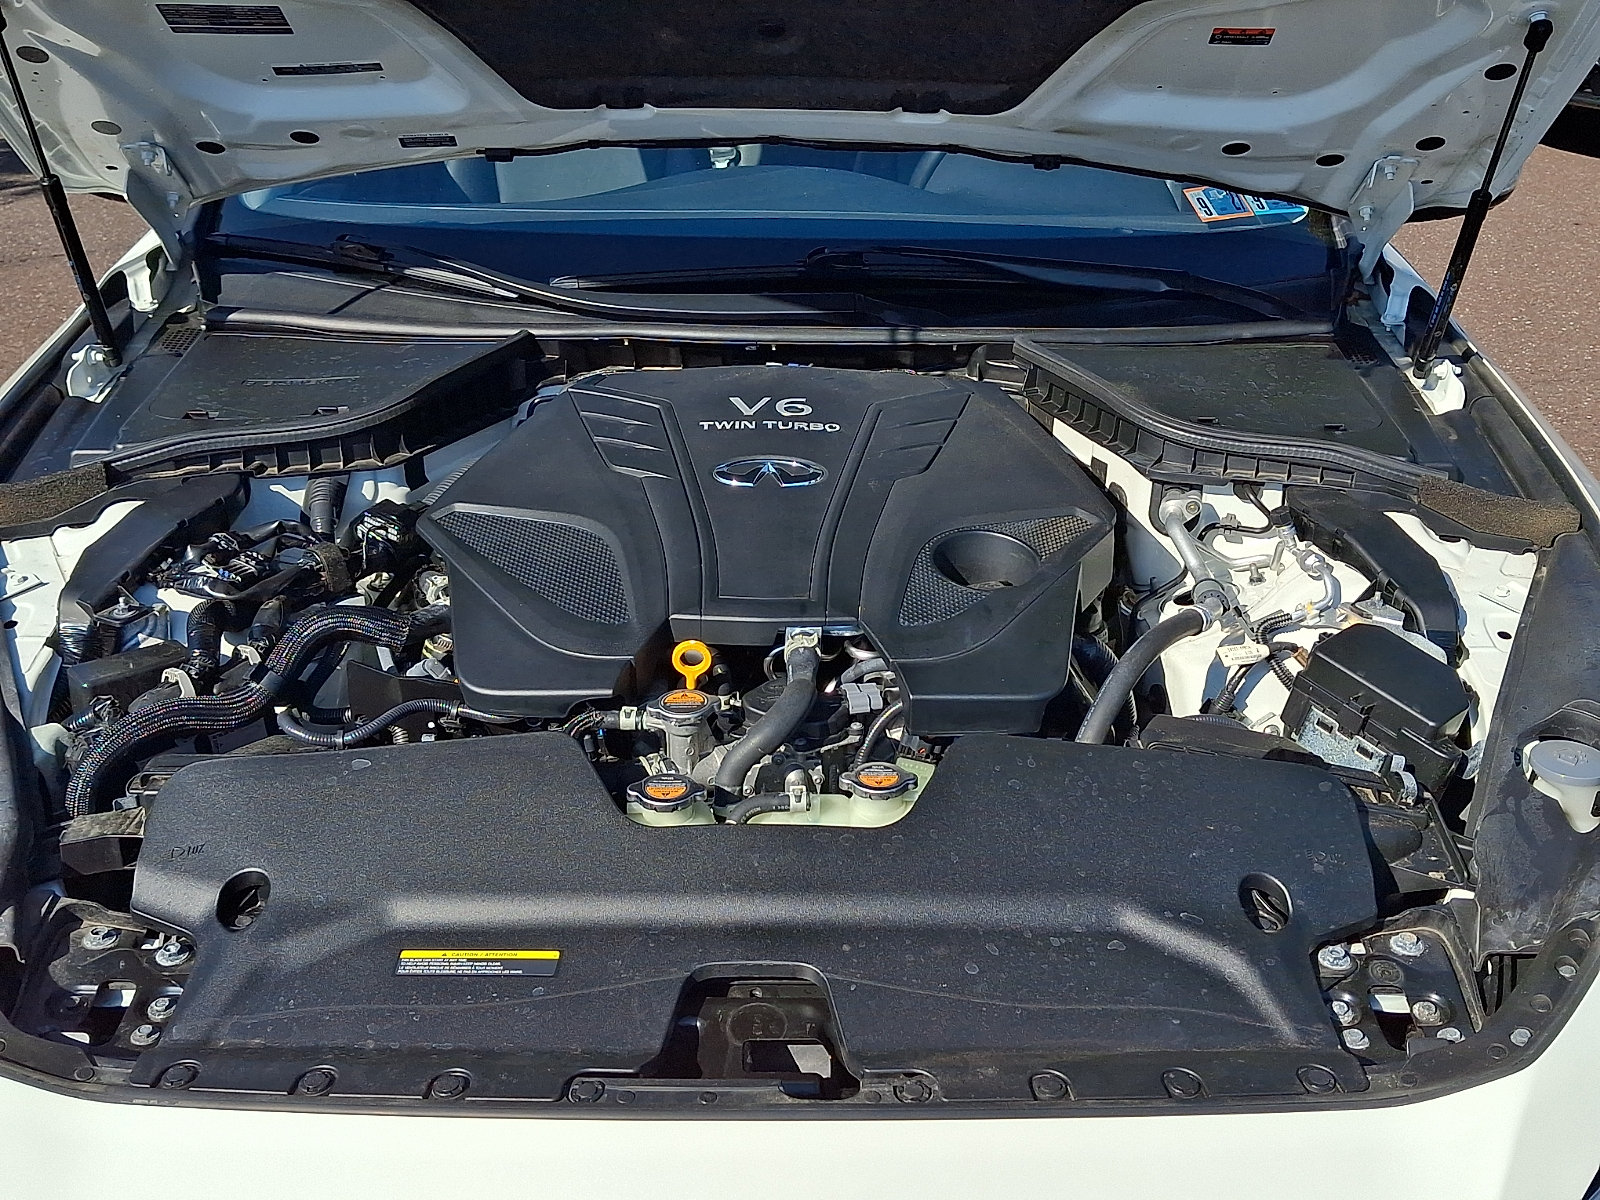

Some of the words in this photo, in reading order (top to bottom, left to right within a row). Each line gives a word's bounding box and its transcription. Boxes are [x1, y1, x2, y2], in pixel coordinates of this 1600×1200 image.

[728, 396, 813, 416] V6
[699, 420, 756, 431] TWIN
[762, 420, 841, 432] TURBO
